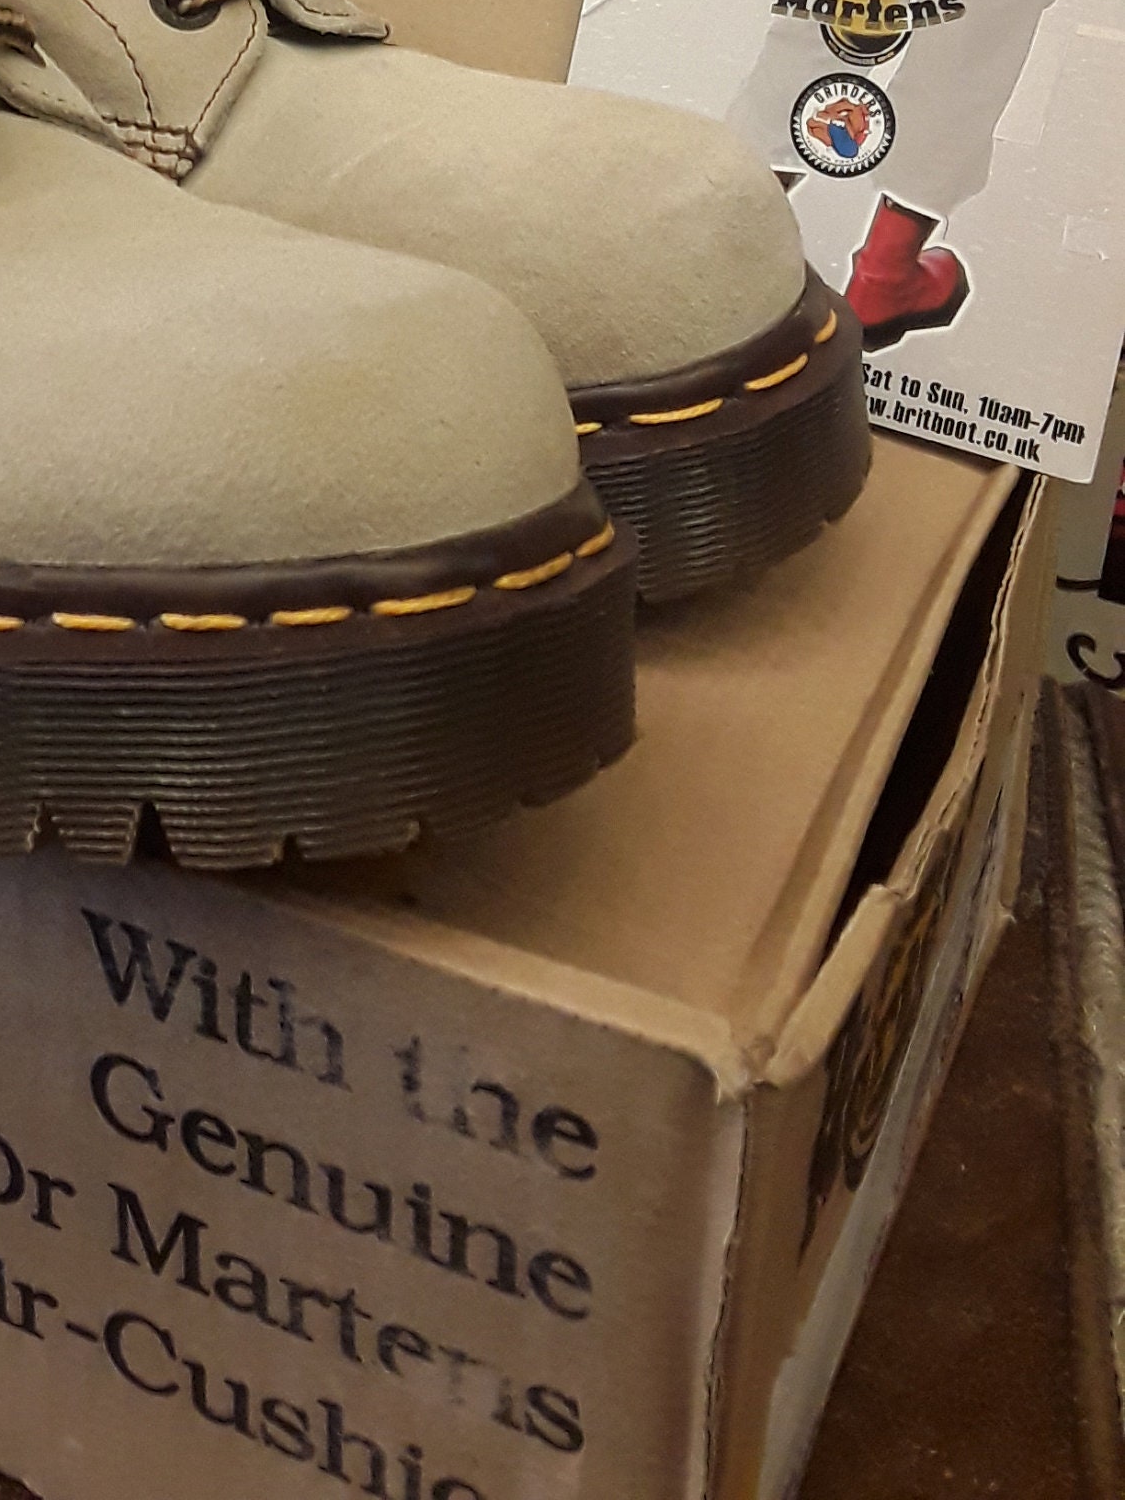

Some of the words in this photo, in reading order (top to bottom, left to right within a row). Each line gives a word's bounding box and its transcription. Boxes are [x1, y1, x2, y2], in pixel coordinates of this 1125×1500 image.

[861, 363, 893, 392] Sat
[901, 375, 922, 399] to
[927, 381, 969, 414] Sun,
[979, 396, 1086, 445] 10am-7pm
[864, 395, 1042, 464] w.britboot.co.uk
[80, 905, 352, 1094] With
[88, 1051, 594, 1322] Genuine
